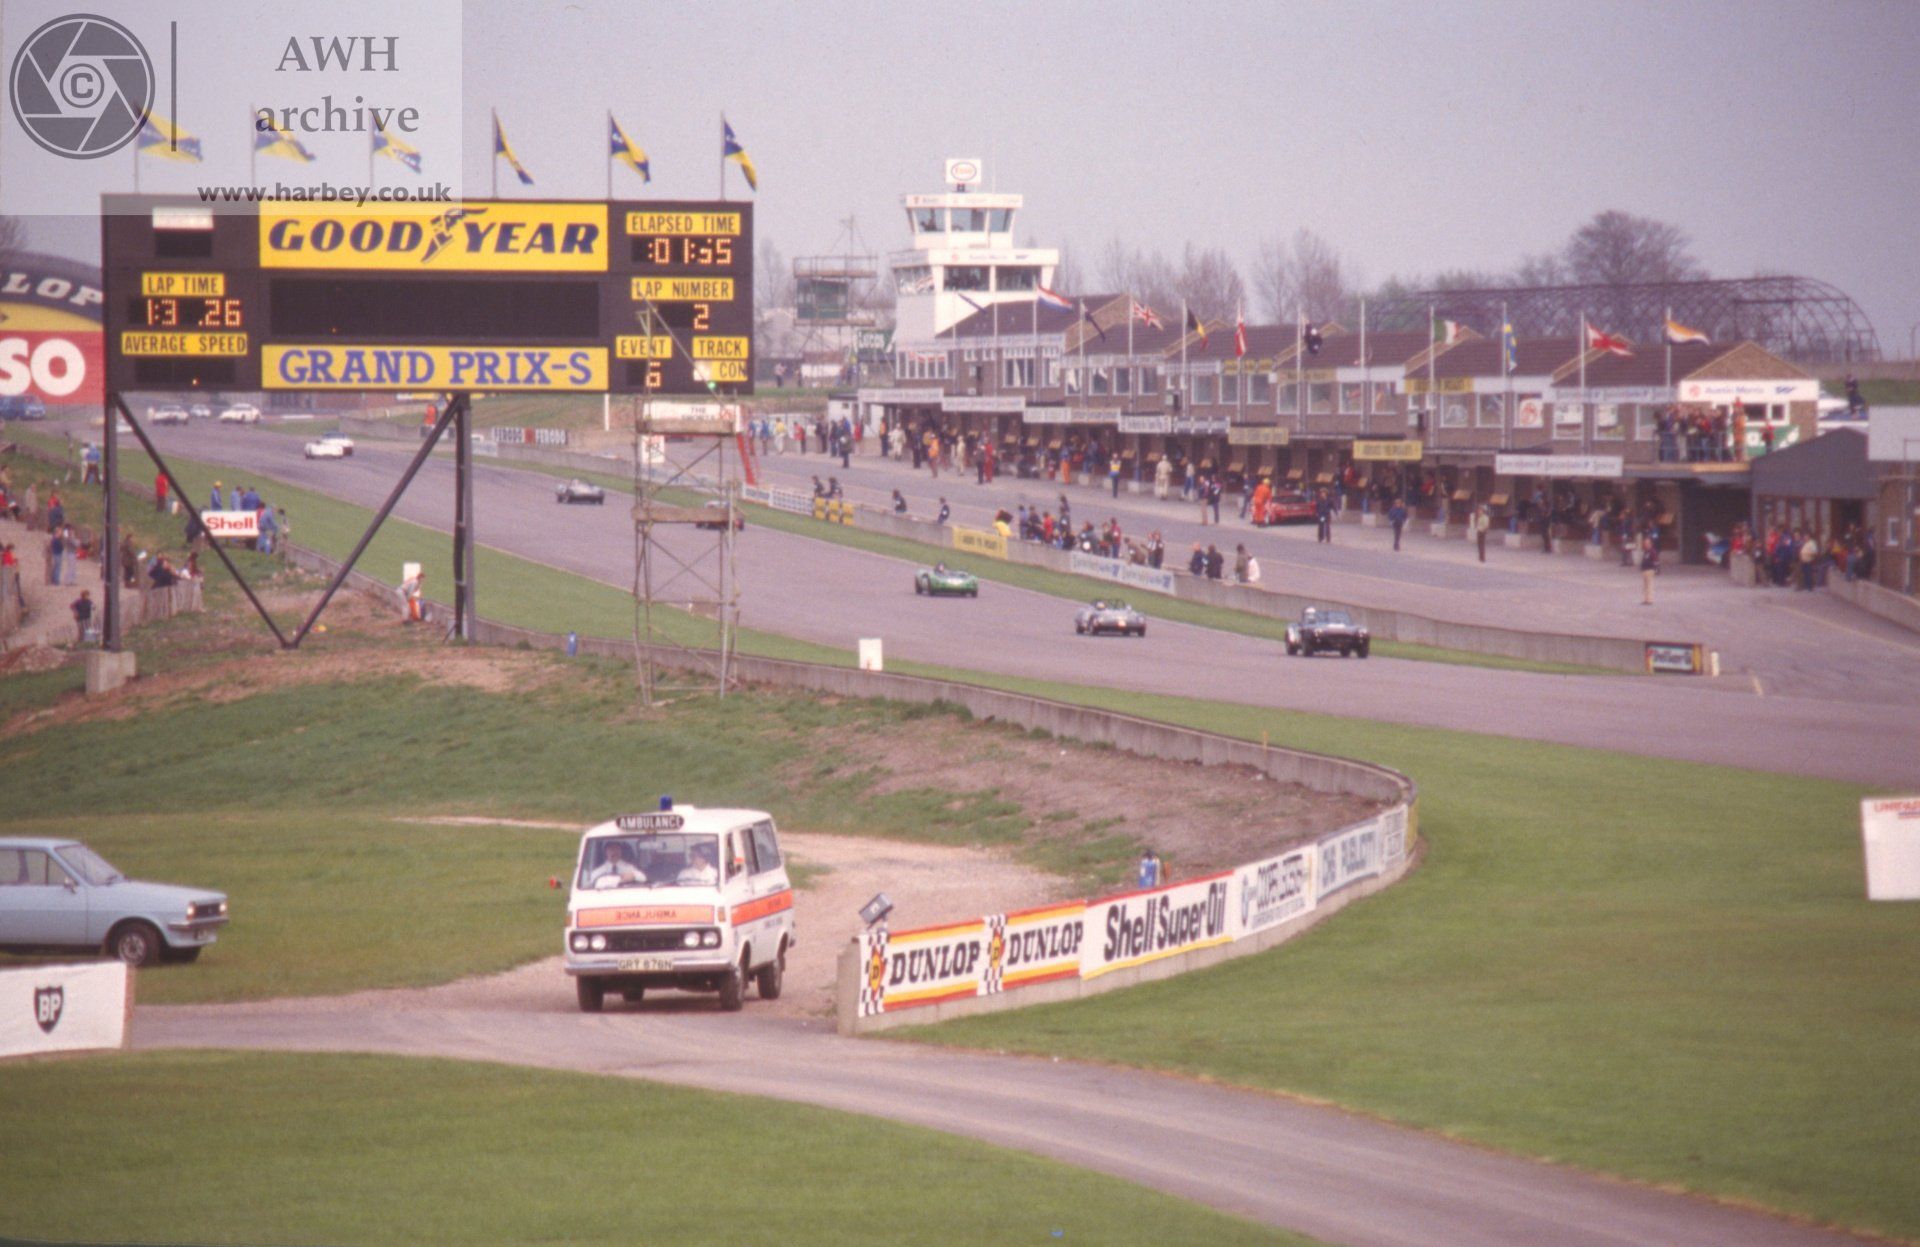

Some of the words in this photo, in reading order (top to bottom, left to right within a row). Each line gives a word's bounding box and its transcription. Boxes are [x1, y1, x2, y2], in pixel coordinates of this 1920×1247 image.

[631, 215, 693, 233] ELAPSED
[702, 215, 736, 233] TIME
[147, 276, 176, 294] LAP
[182, 276, 219, 294] TIME
[635, 281, 662, 298] LAP
[672, 281, 730, 298] NUMBER
[693, 303, 709, 330] 2
[124, 334, 187, 352] AVERAGE
[199, 334, 246, 352] SPEED
[619, 339, 667, 356] EVENT
[698, 339, 742, 356] TRACK
[279, 349, 434, 385] GRAND
[450, 351, 593, 386] PRIX-S
[719, 360, 748, 378] CON
[205, 516, 254, 530] Shell
[618, 815, 682, 831] AMBULANCE
[1104, 894, 1157, 962] Shell
[1007, 920, 1084, 966] DUNLOP
[889, 940, 980, 987] DUNLOP
[38, 994, 62, 1022] BP
